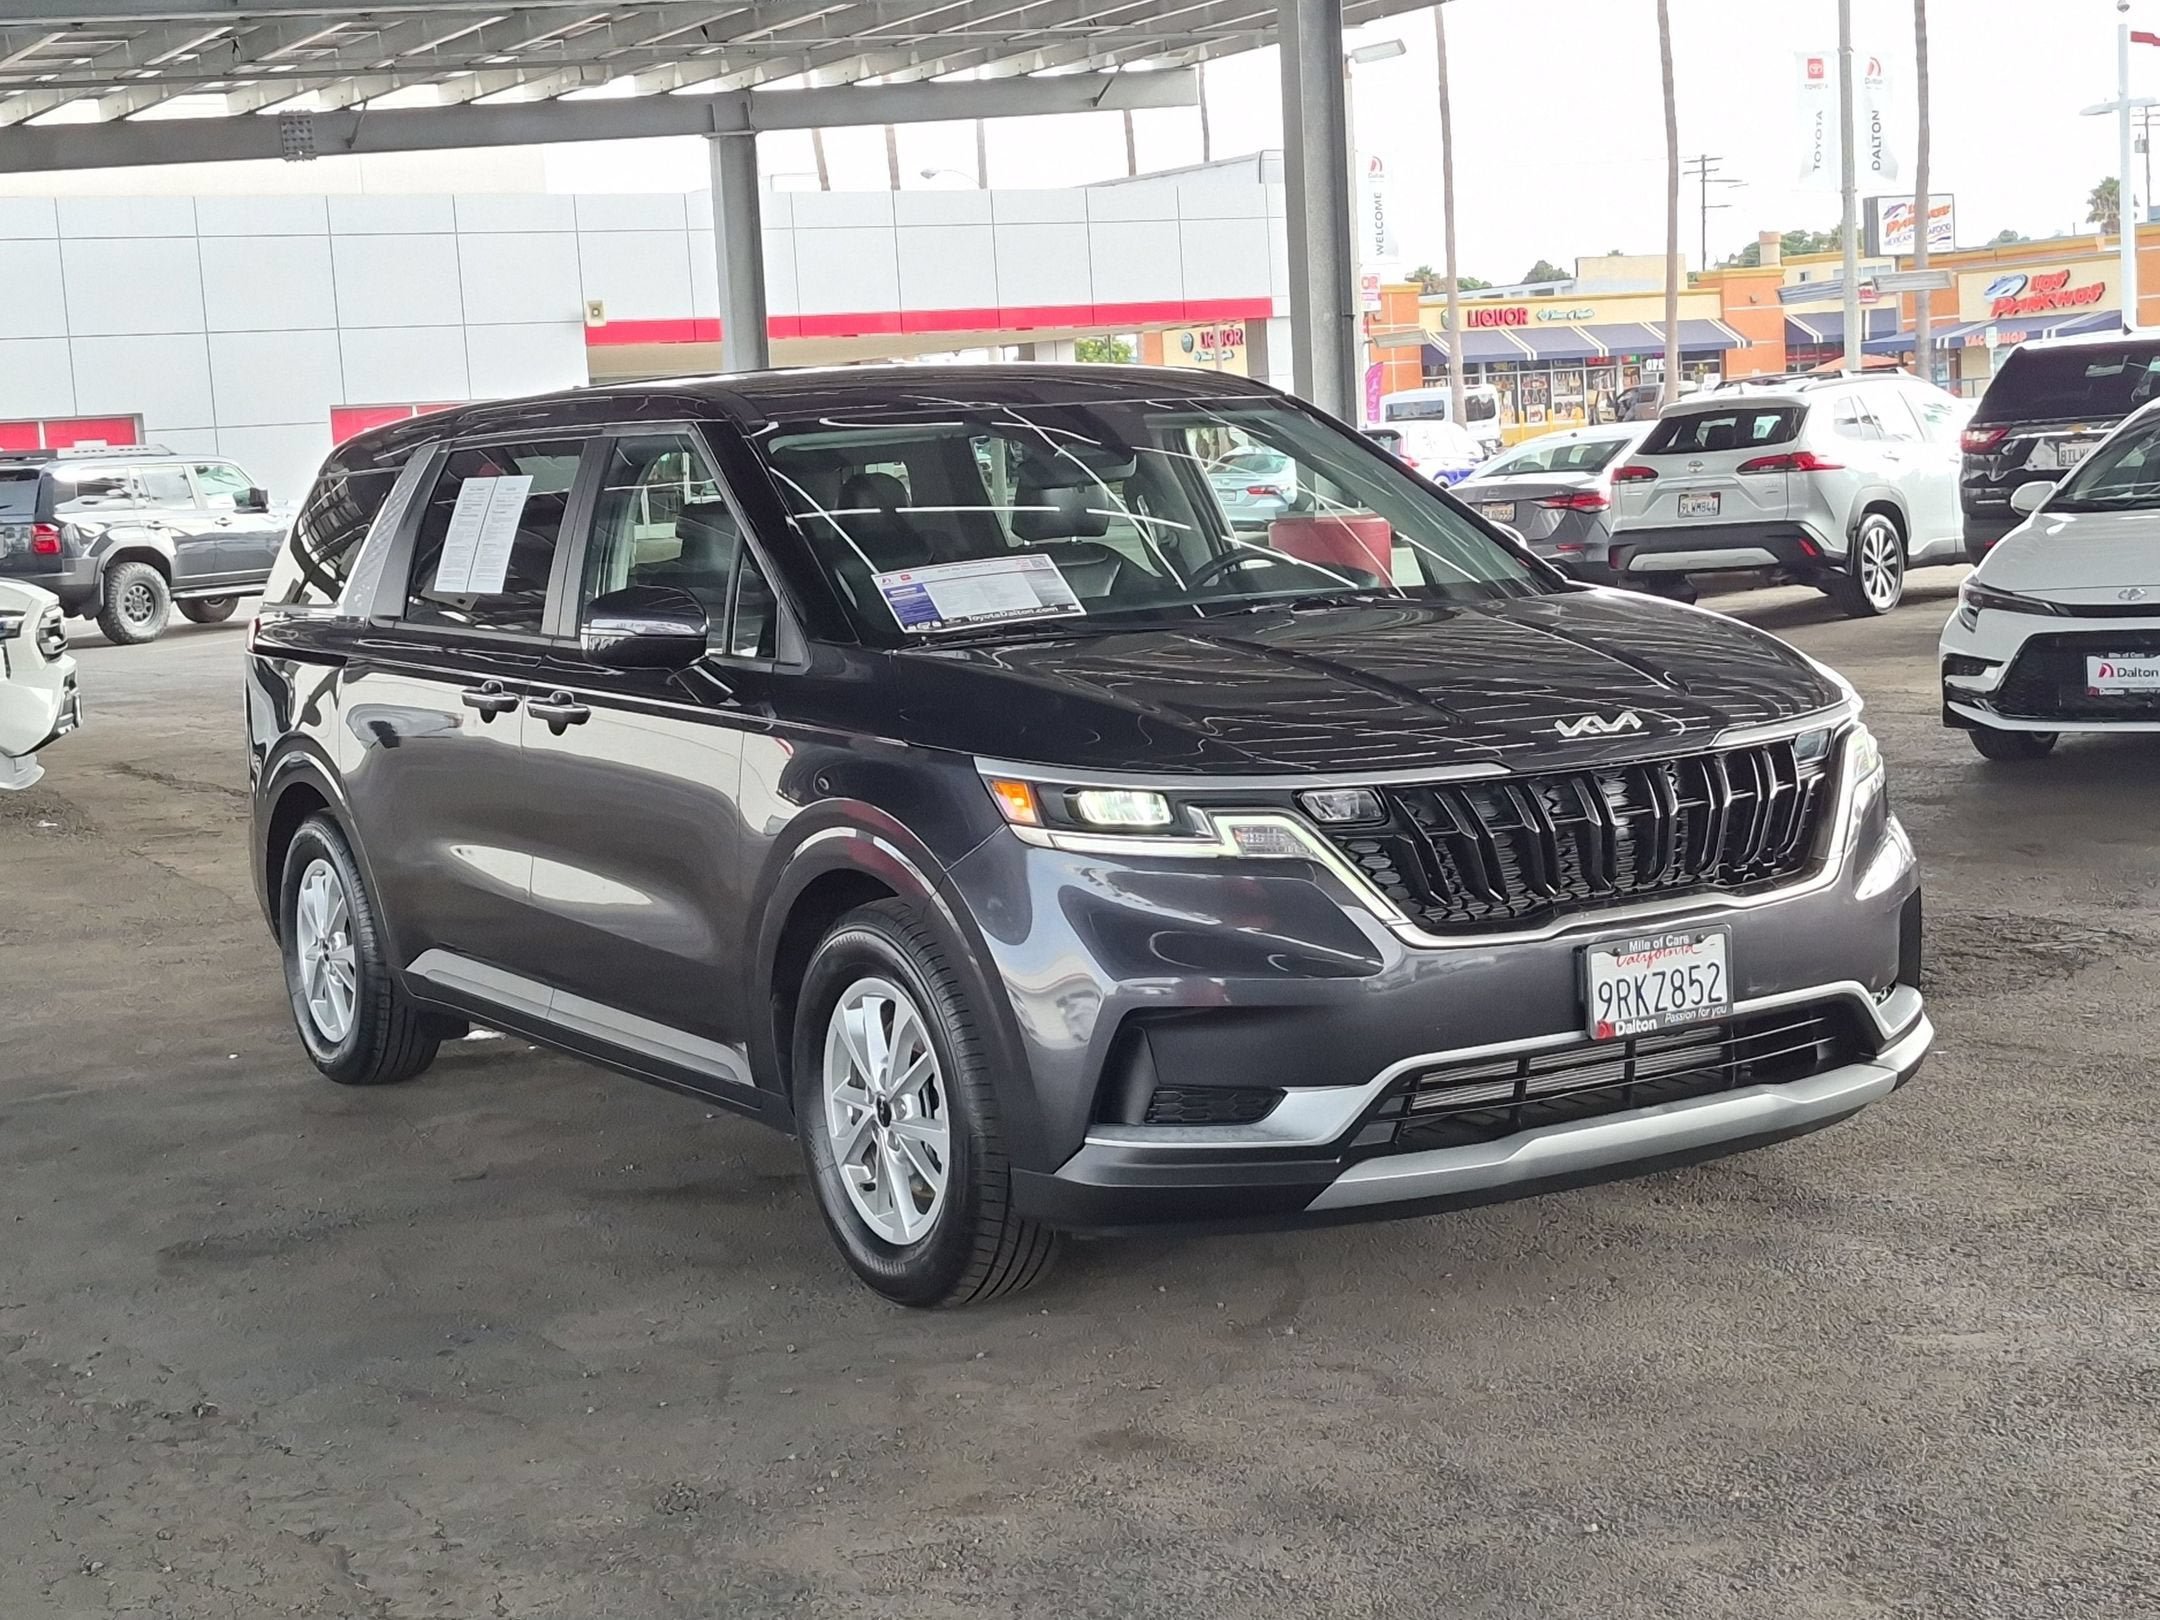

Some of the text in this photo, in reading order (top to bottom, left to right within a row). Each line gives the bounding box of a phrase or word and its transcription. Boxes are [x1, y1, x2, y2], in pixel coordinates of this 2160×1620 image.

[1812, 110, 1823, 172] TOYOTA
[1871, 110, 1882, 171] DALTON
[1373, 192, 1385, 256] WELCOME
[2031, 269, 2070, 292] LOS
[1467, 308, 1528, 327] LIQUOR
[1996, 330, 2027, 345] SHOP
[1646, 358, 1665, 371] OPE
[2117, 667, 2159, 678] Dalton
[1554, 711, 1643, 737] KIA
[1629, 934, 1690, 953] Mile of Cars
[1598, 962, 1723, 1020] 9RKZ852
[1615, 1005, 1728, 1036] Dalton Passion for you
